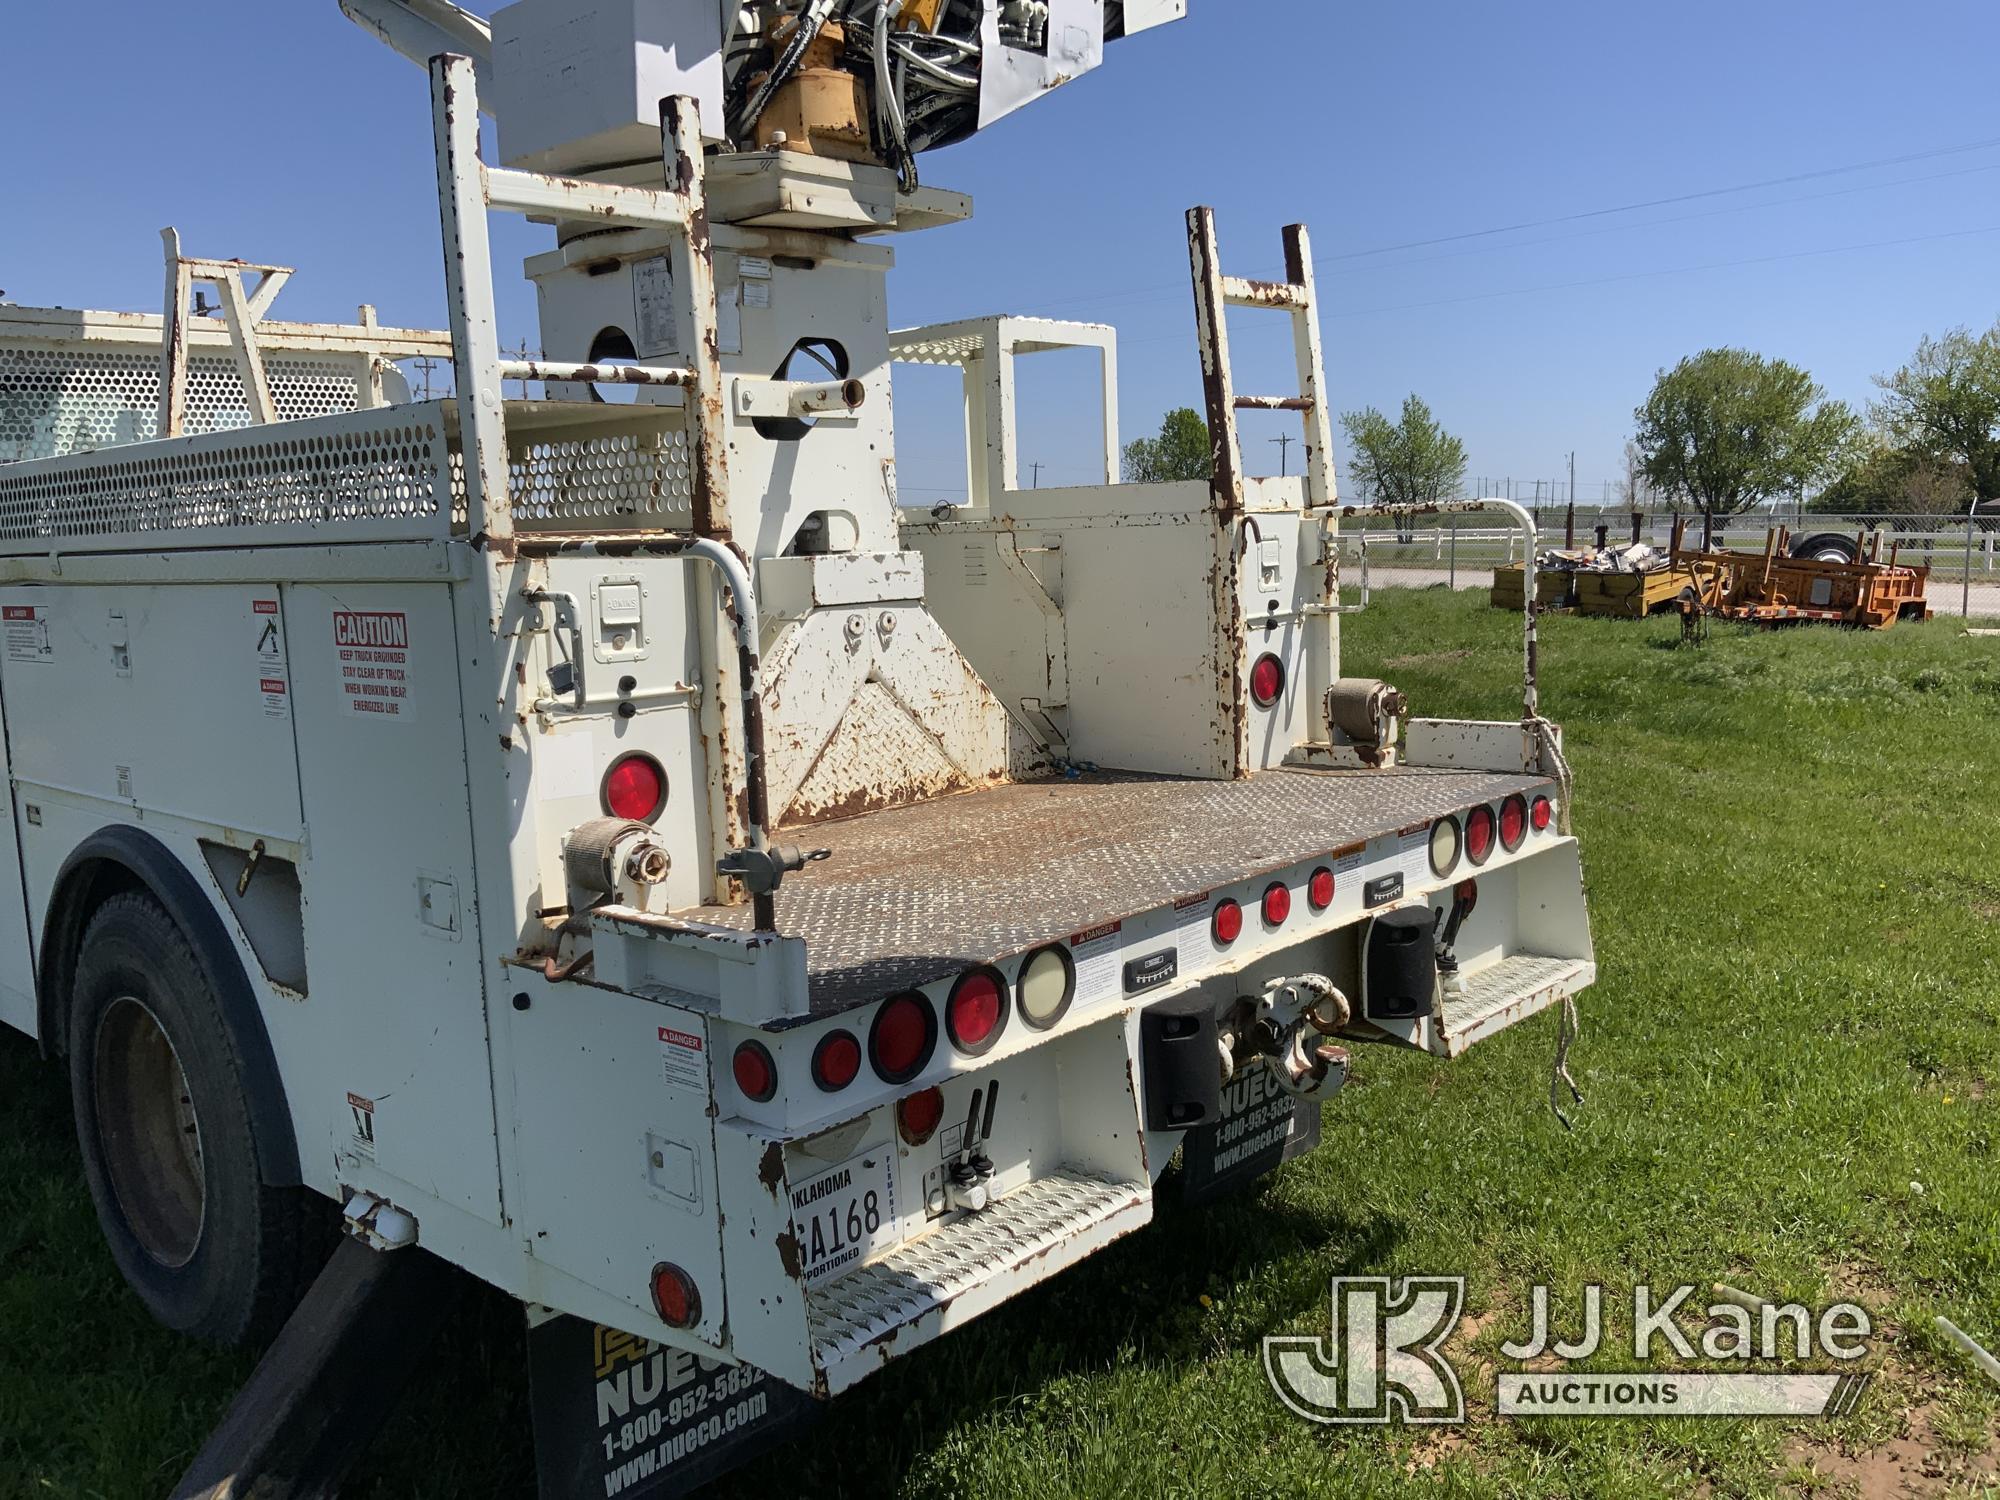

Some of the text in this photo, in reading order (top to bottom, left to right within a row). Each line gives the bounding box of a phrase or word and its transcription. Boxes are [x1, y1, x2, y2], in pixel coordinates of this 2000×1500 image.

[335, 615, 406, 646] CAUTION
[340, 649, 406, 664] KEEP TRUCK GROUNDED
[342, 666, 406, 681] STAY CLEAR OF TRUCK
[344, 682, 407, 698] WHEN WORKING NEAR
[353, 700, 400, 715] ENERGIZED LINE
[1086, 924, 1114, 940] DANGER
[669, 1032, 699, 1047] DANGER
[886, 1155, 897, 1232] PERMANENT
[803, 1247, 860, 1281] PORTIONED
[604, 1391, 768, 1498] www.nueco.com
